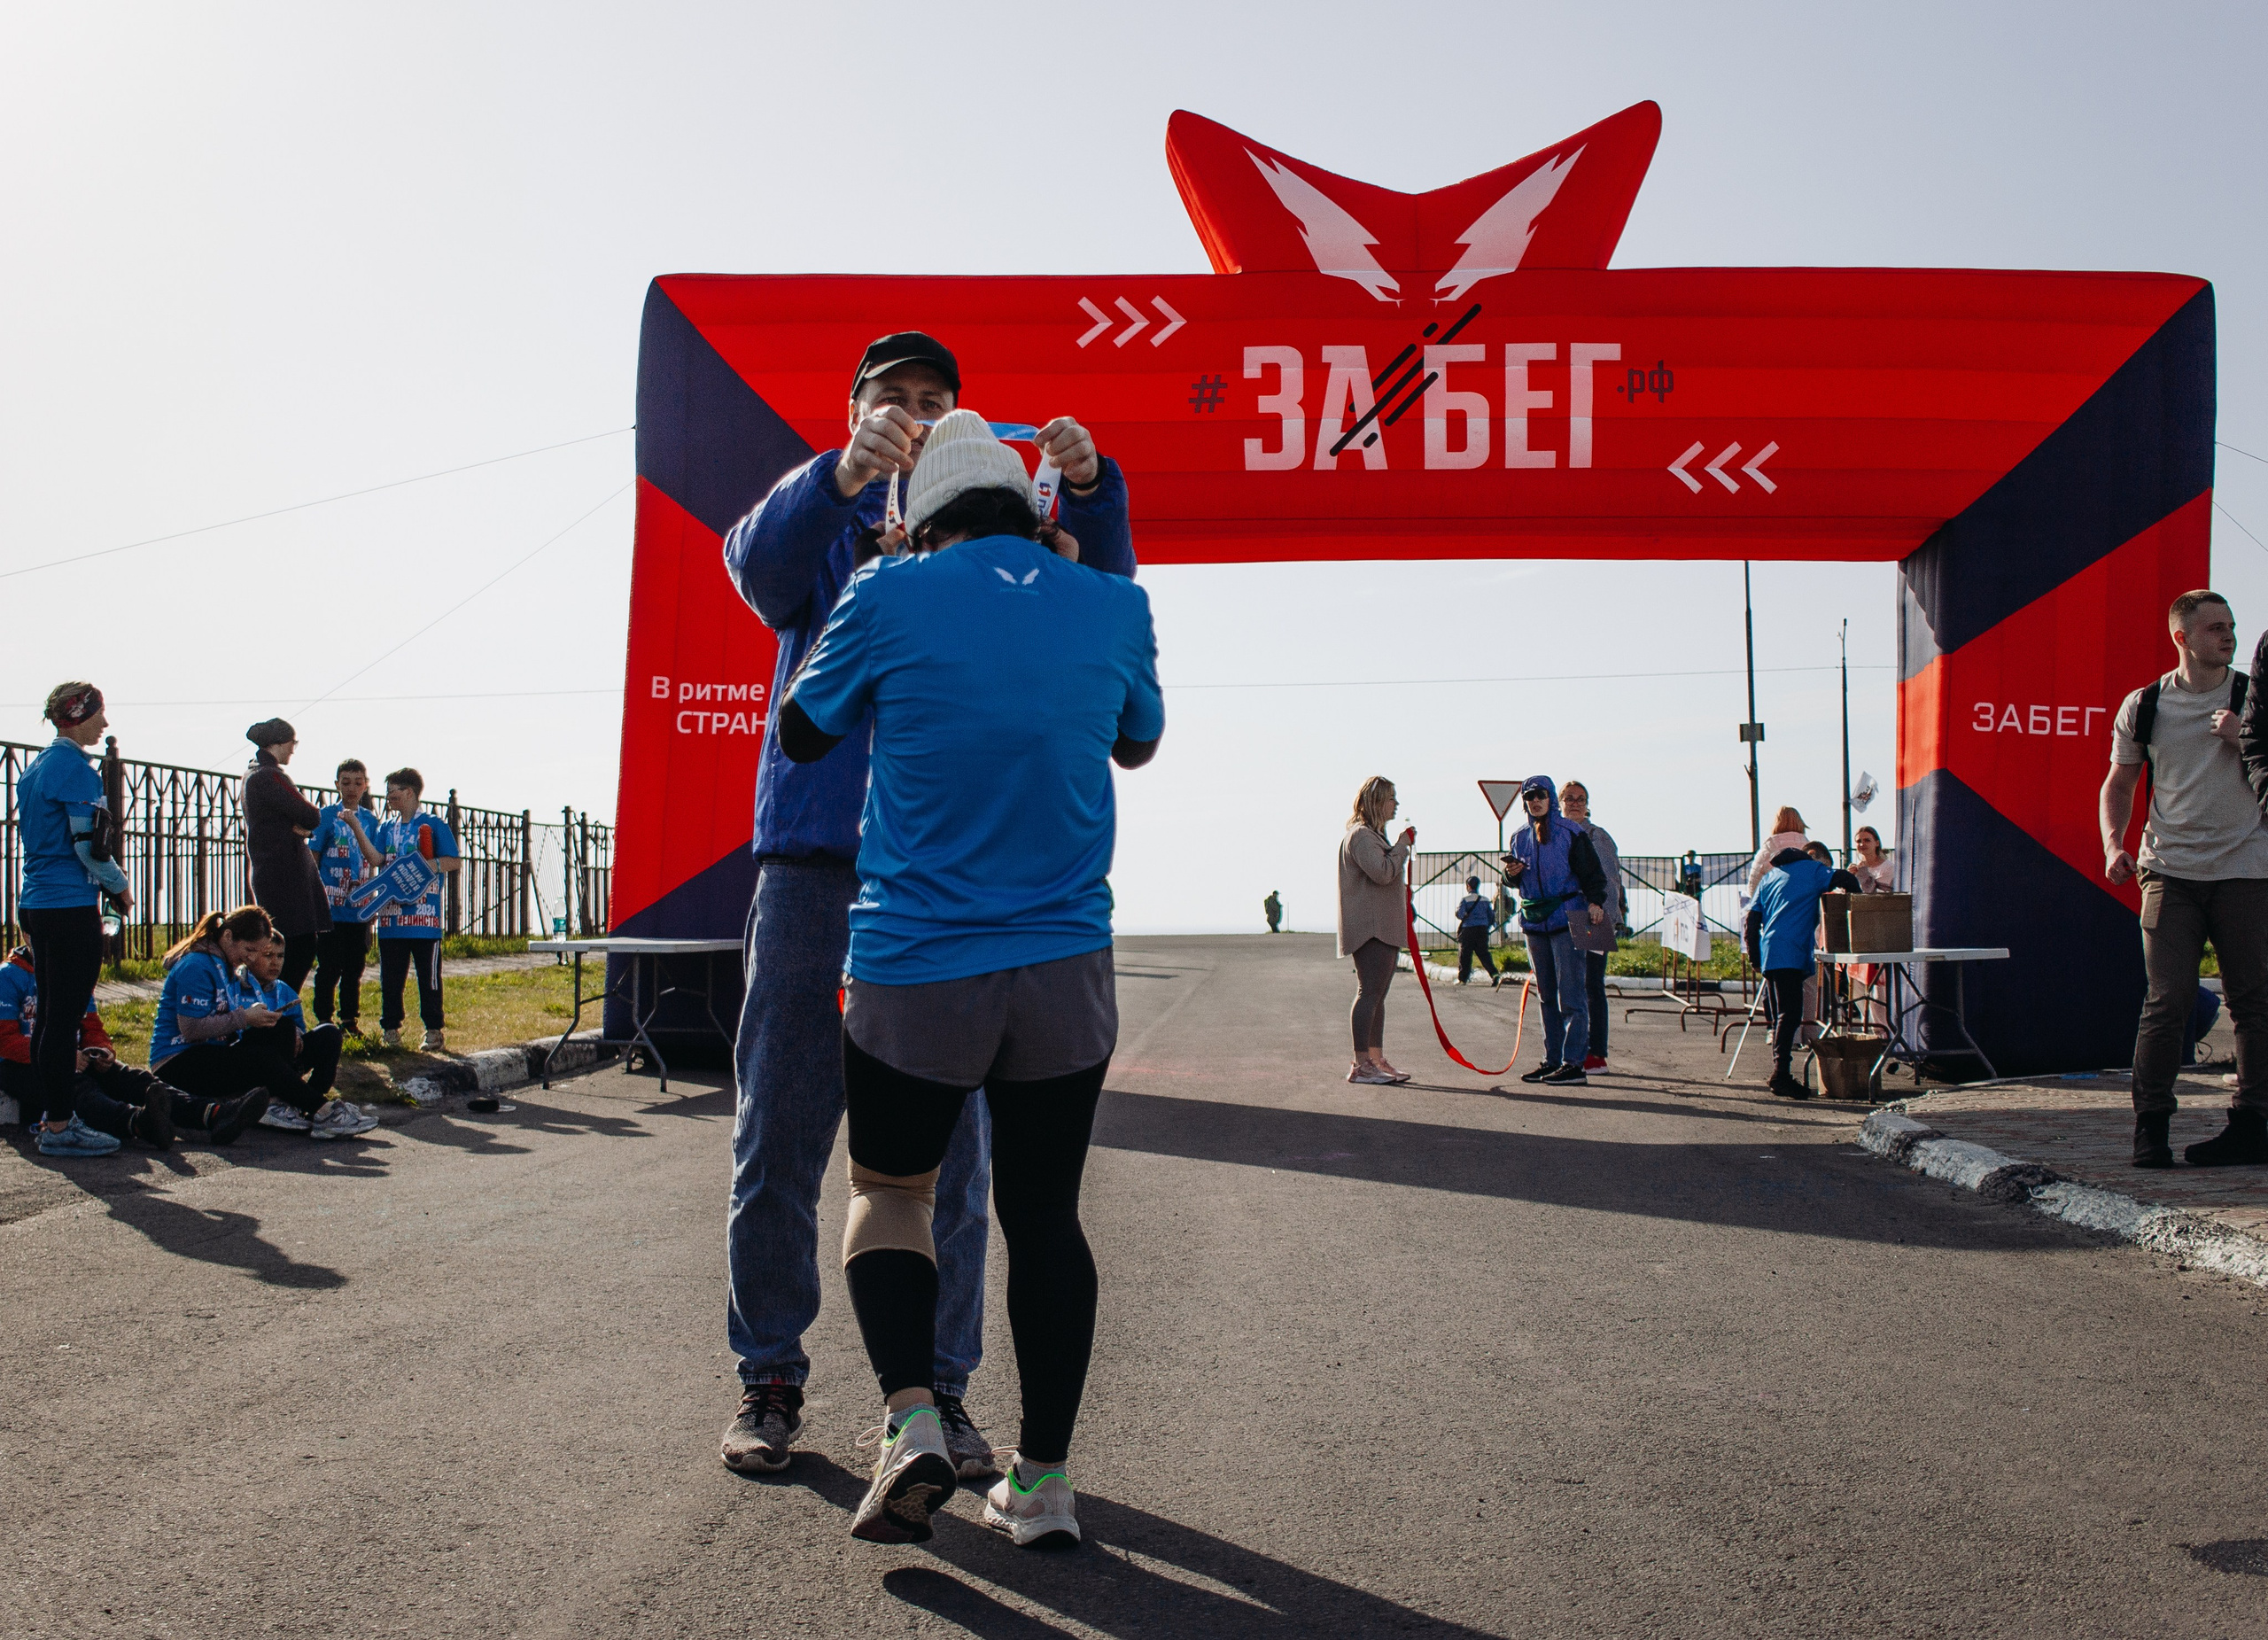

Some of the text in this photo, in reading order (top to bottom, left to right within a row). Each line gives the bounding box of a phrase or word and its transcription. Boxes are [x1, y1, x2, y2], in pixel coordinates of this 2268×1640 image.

[651, 675, 765, 703] В ритме
[676, 710, 769, 735] СТРАН
[407, 860, 426, 883] РИТМЕ
[416, 904, 436, 916] 2024
